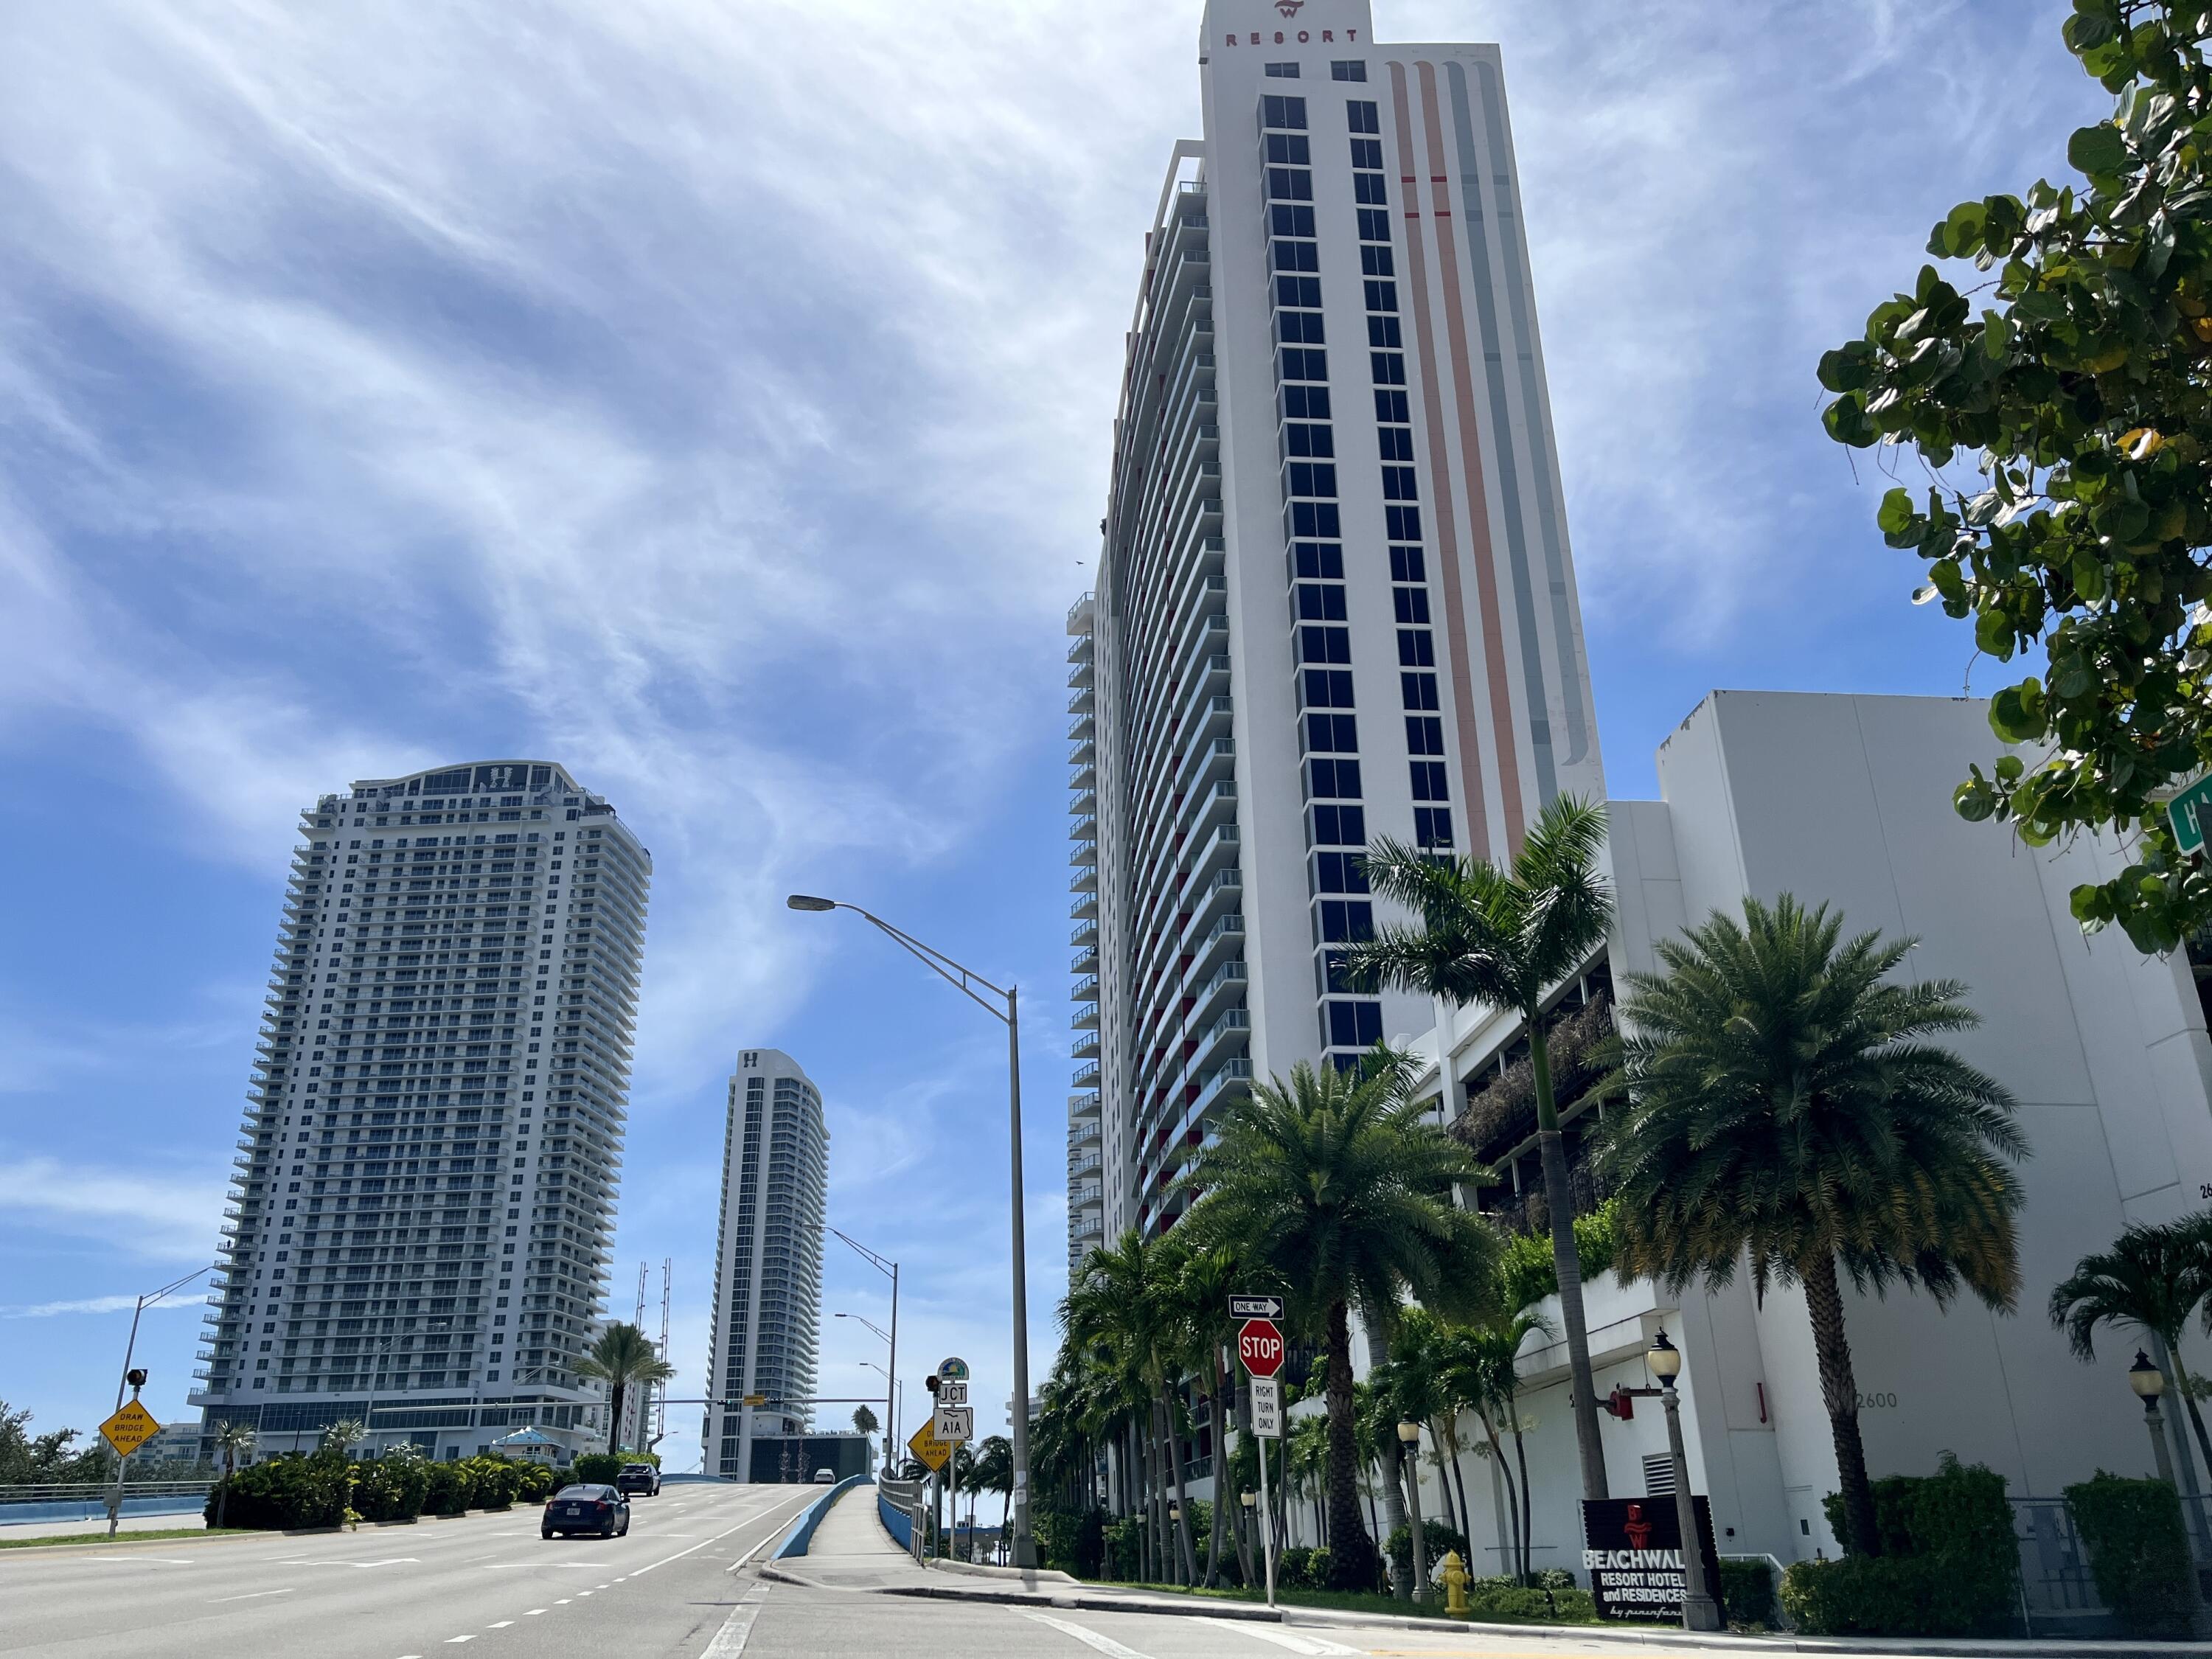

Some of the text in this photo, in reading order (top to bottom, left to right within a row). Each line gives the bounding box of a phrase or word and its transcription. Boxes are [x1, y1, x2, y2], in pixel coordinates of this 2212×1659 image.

[1226, 29, 1357, 46] RESORT
[2199, 1183, 2212, 1199] 26
[1235, 1302, 1267, 1312] ONE WAY
[1242, 1336, 1281, 1360] STOP
[941, 1386, 965, 1401] JCT
[1256, 1385, 1274, 1398] RIGHT
[1855, 1392, 1897, 1408] 2600
[1258, 1401, 1274, 1413] TURN
[119, 1413, 144, 1421] DRAW
[1259, 1417, 1274, 1430] ONLY
[114, 1424, 145, 1432] BRIDGE
[942, 1421, 961, 1434] A1A
[924, 1439, 947, 1447] BRIDGE
[925, 1448, 947, 1457] AHEAD
[1582, 1549, 1705, 1570] BEACHWAL
[1600, 1572, 1686, 1587] RESORT HOTEL
[1603, 1587, 1687, 1604] and RESIDENCES
[1610, 1606, 1683, 1619] by pininfari
